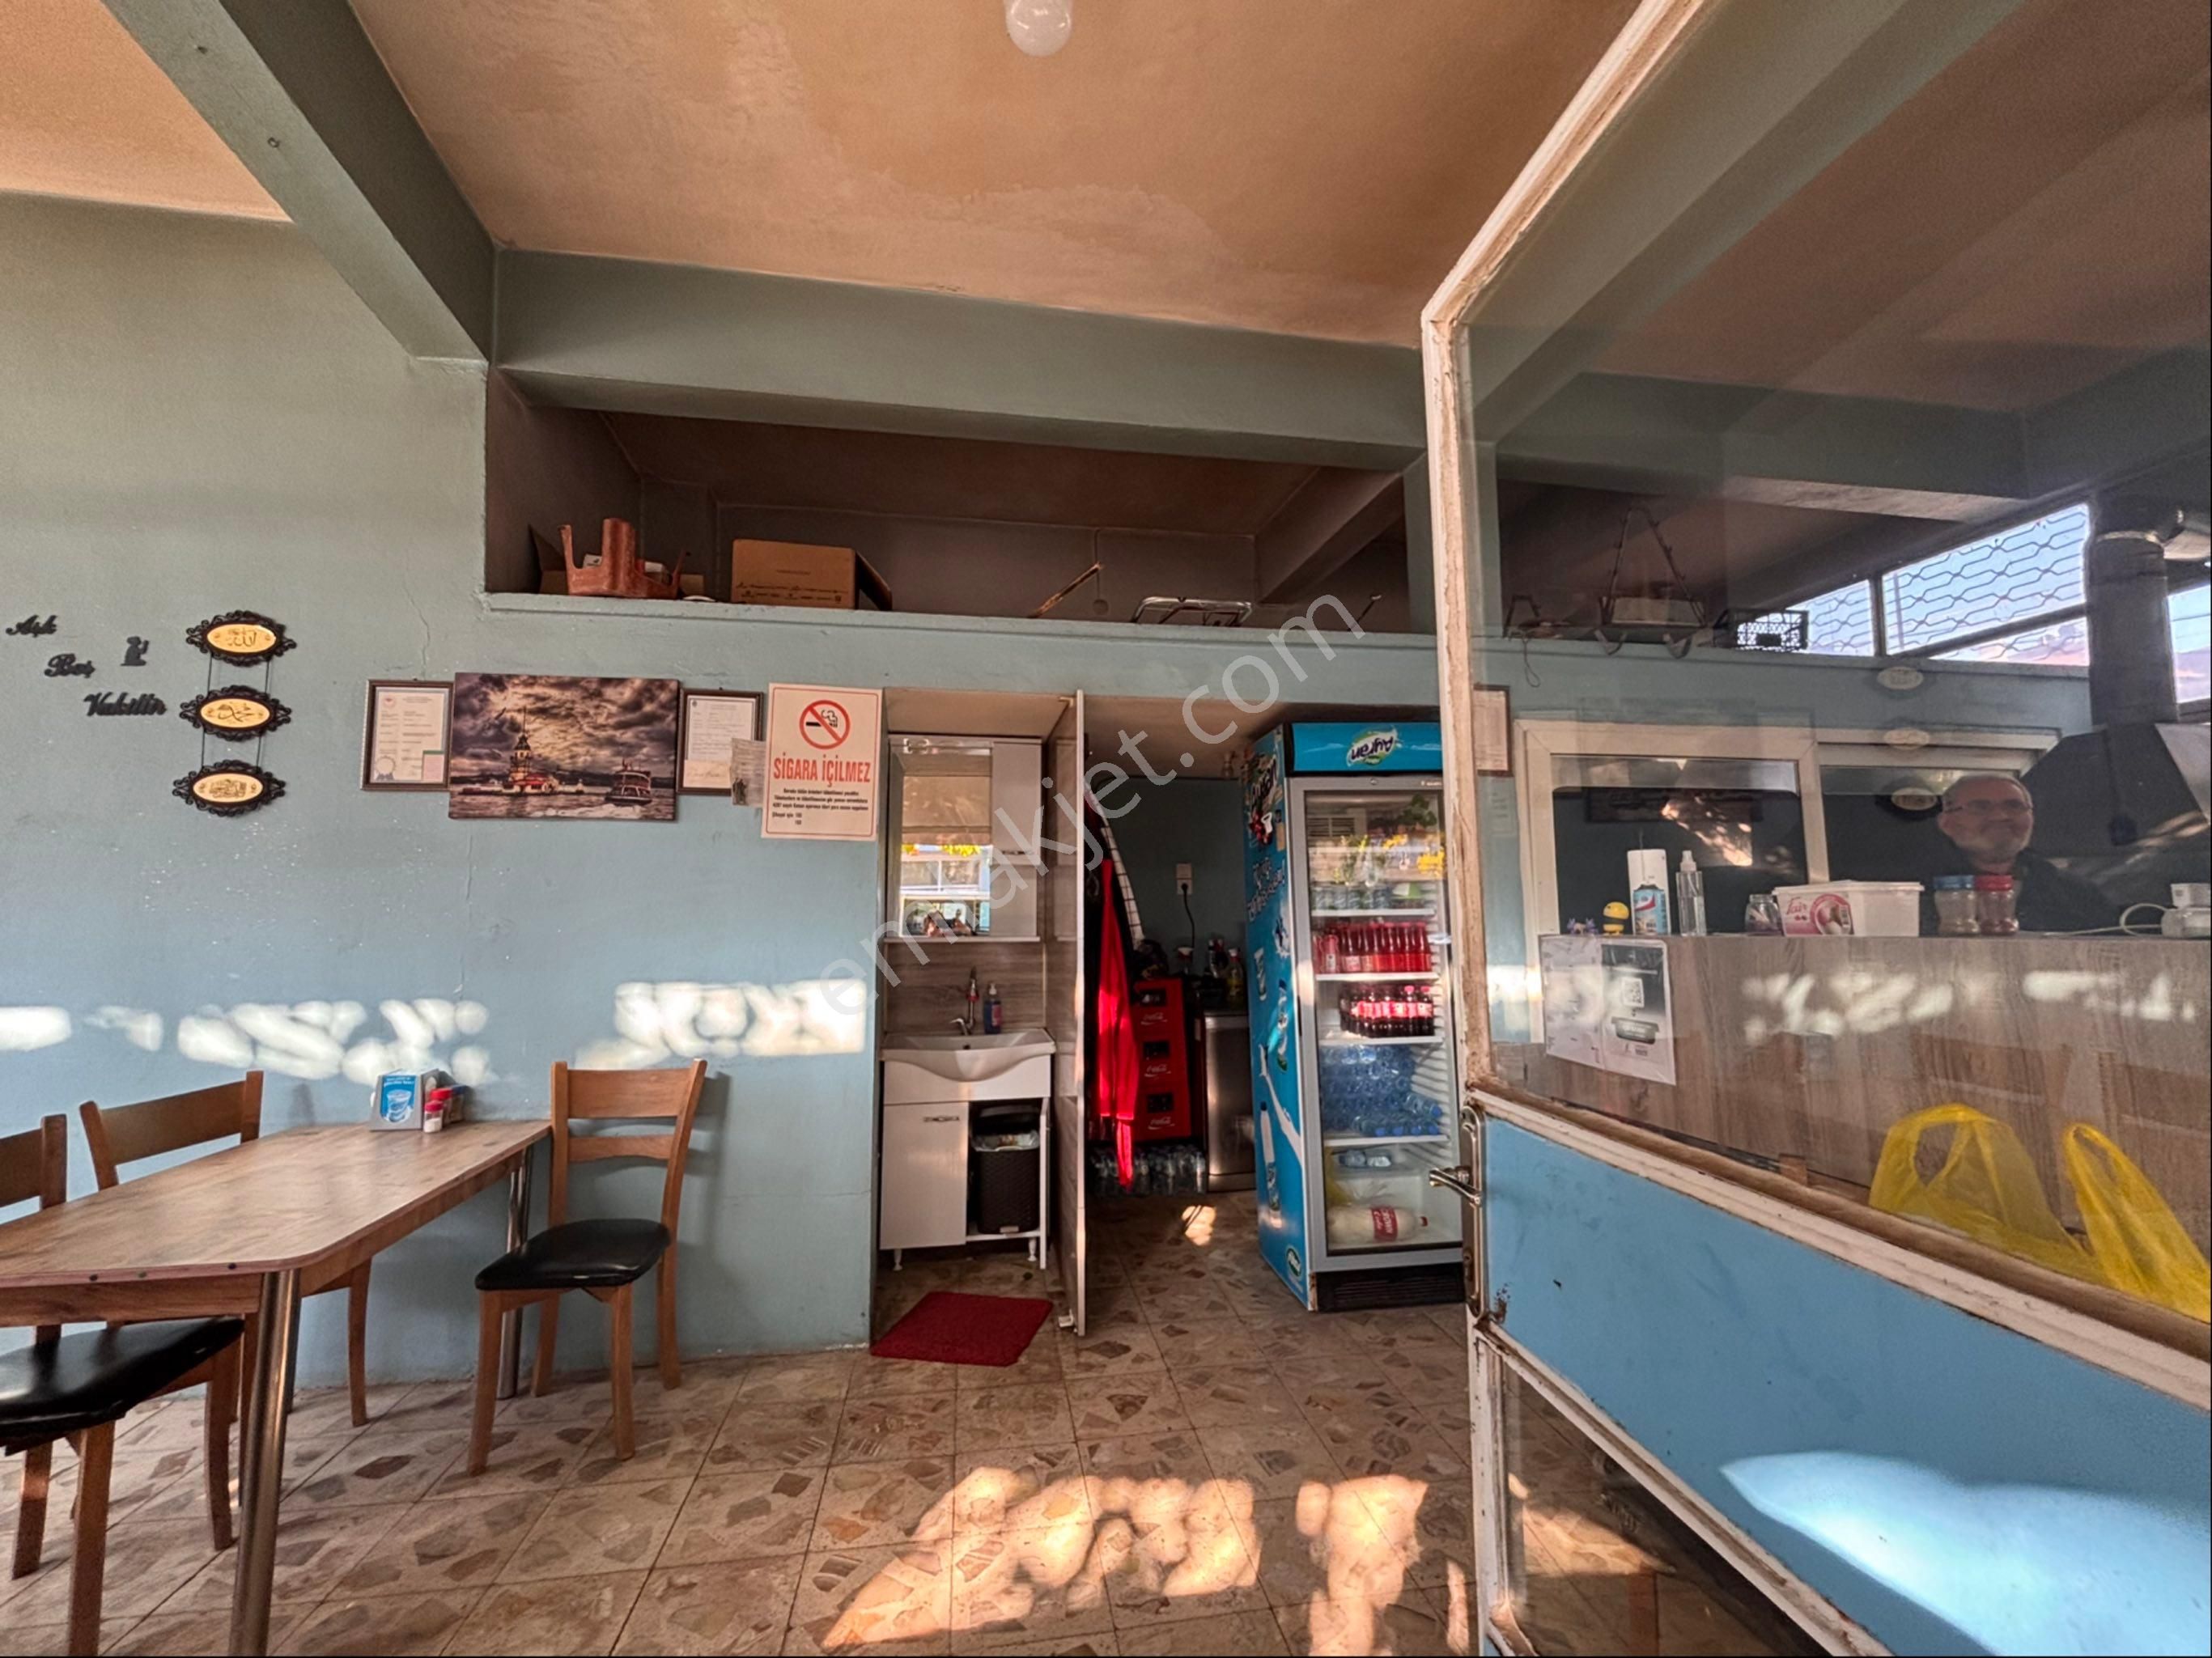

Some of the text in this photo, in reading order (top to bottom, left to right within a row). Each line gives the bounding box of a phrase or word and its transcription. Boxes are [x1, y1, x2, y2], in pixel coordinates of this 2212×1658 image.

[1352, 736, 1394, 761] Ayran
[773, 752, 818, 780] SİGARA
[822, 754, 871, 787] İÇİLMEZ
